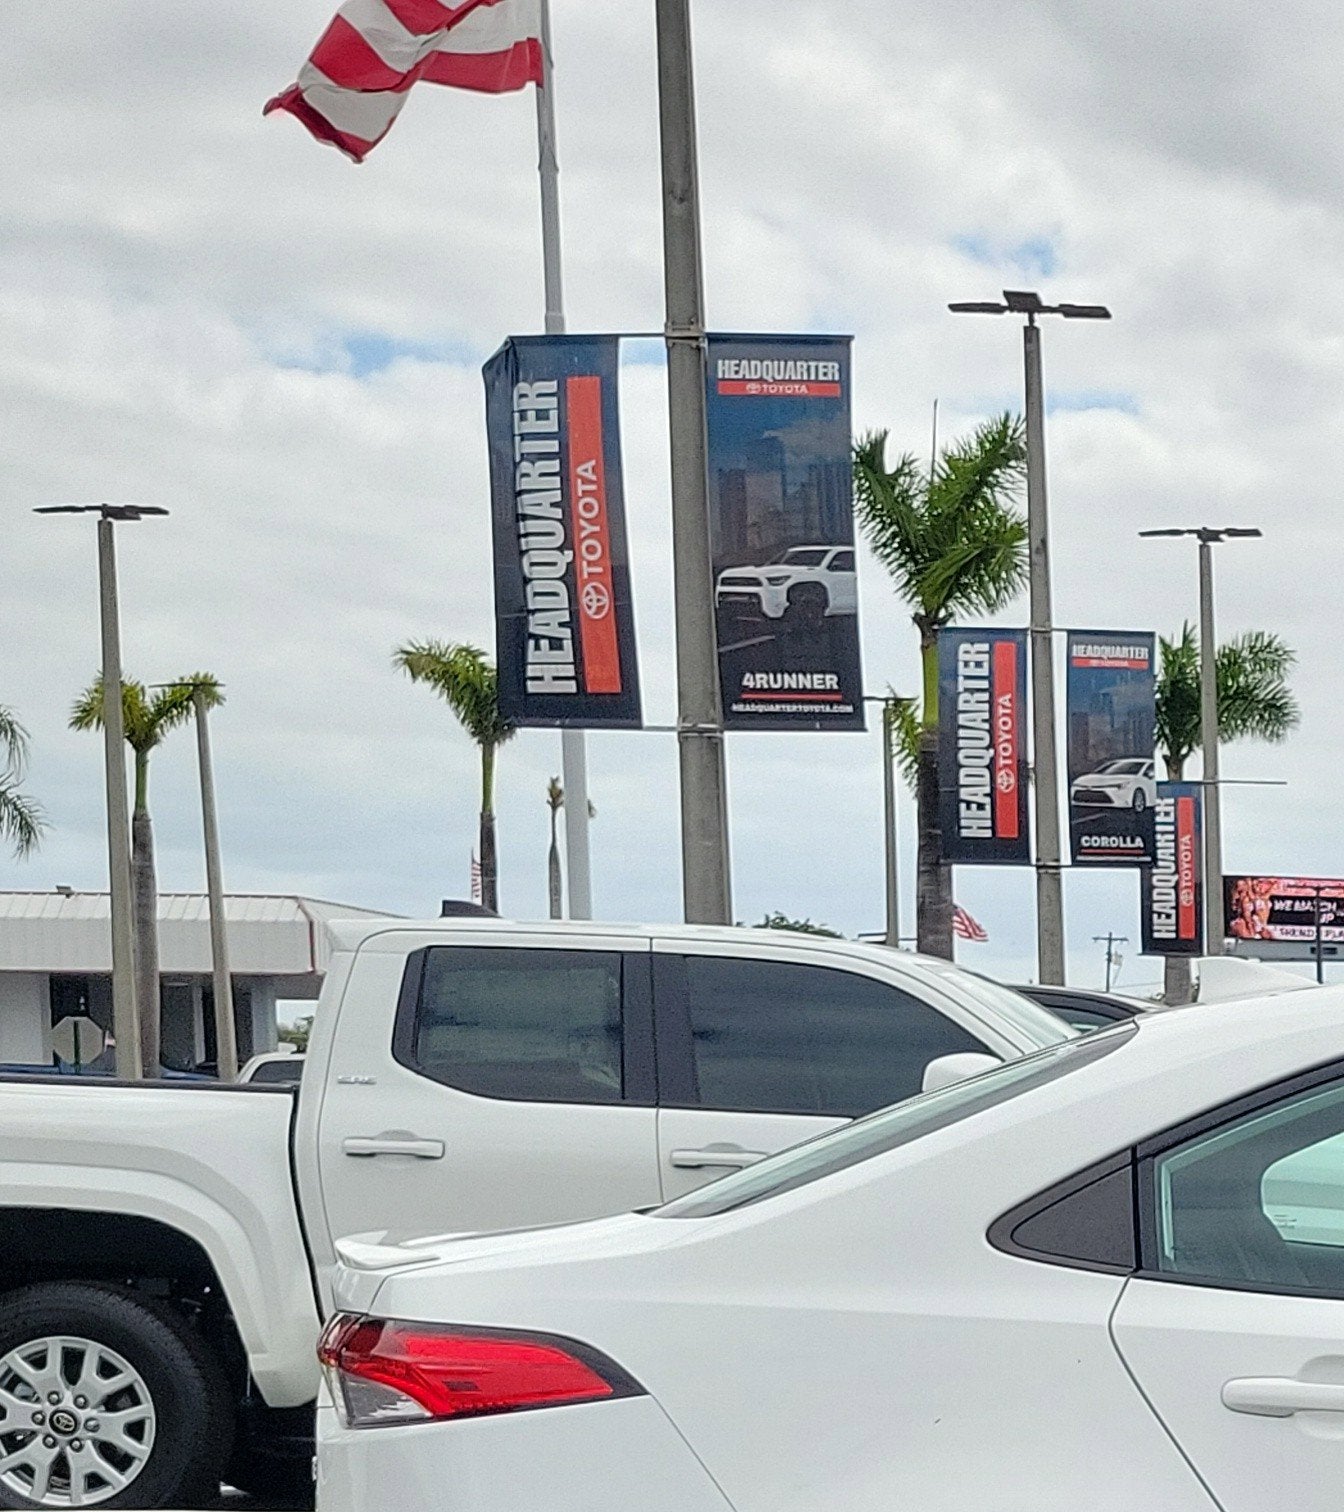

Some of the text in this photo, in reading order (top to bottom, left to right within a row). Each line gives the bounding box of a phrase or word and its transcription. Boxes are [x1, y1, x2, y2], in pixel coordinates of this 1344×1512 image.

[717, 359, 840, 381] HEADQUARTER
[763, 384, 808, 394] TOYOTA
[513, 379, 578, 694] HEADQUARTER
[576, 459, 603, 579] TOYOTA
[1072, 645, 1149, 660] HEADQUARTER
[741, 672, 839, 689] 4RUNNER
[958, 642, 994, 838] HEADQUARTER
[1000, 693, 1013, 765] TOYOTA
[1081, 835, 1144, 848] COROLLA
[1180, 834, 1192, 889] TOYOTA
